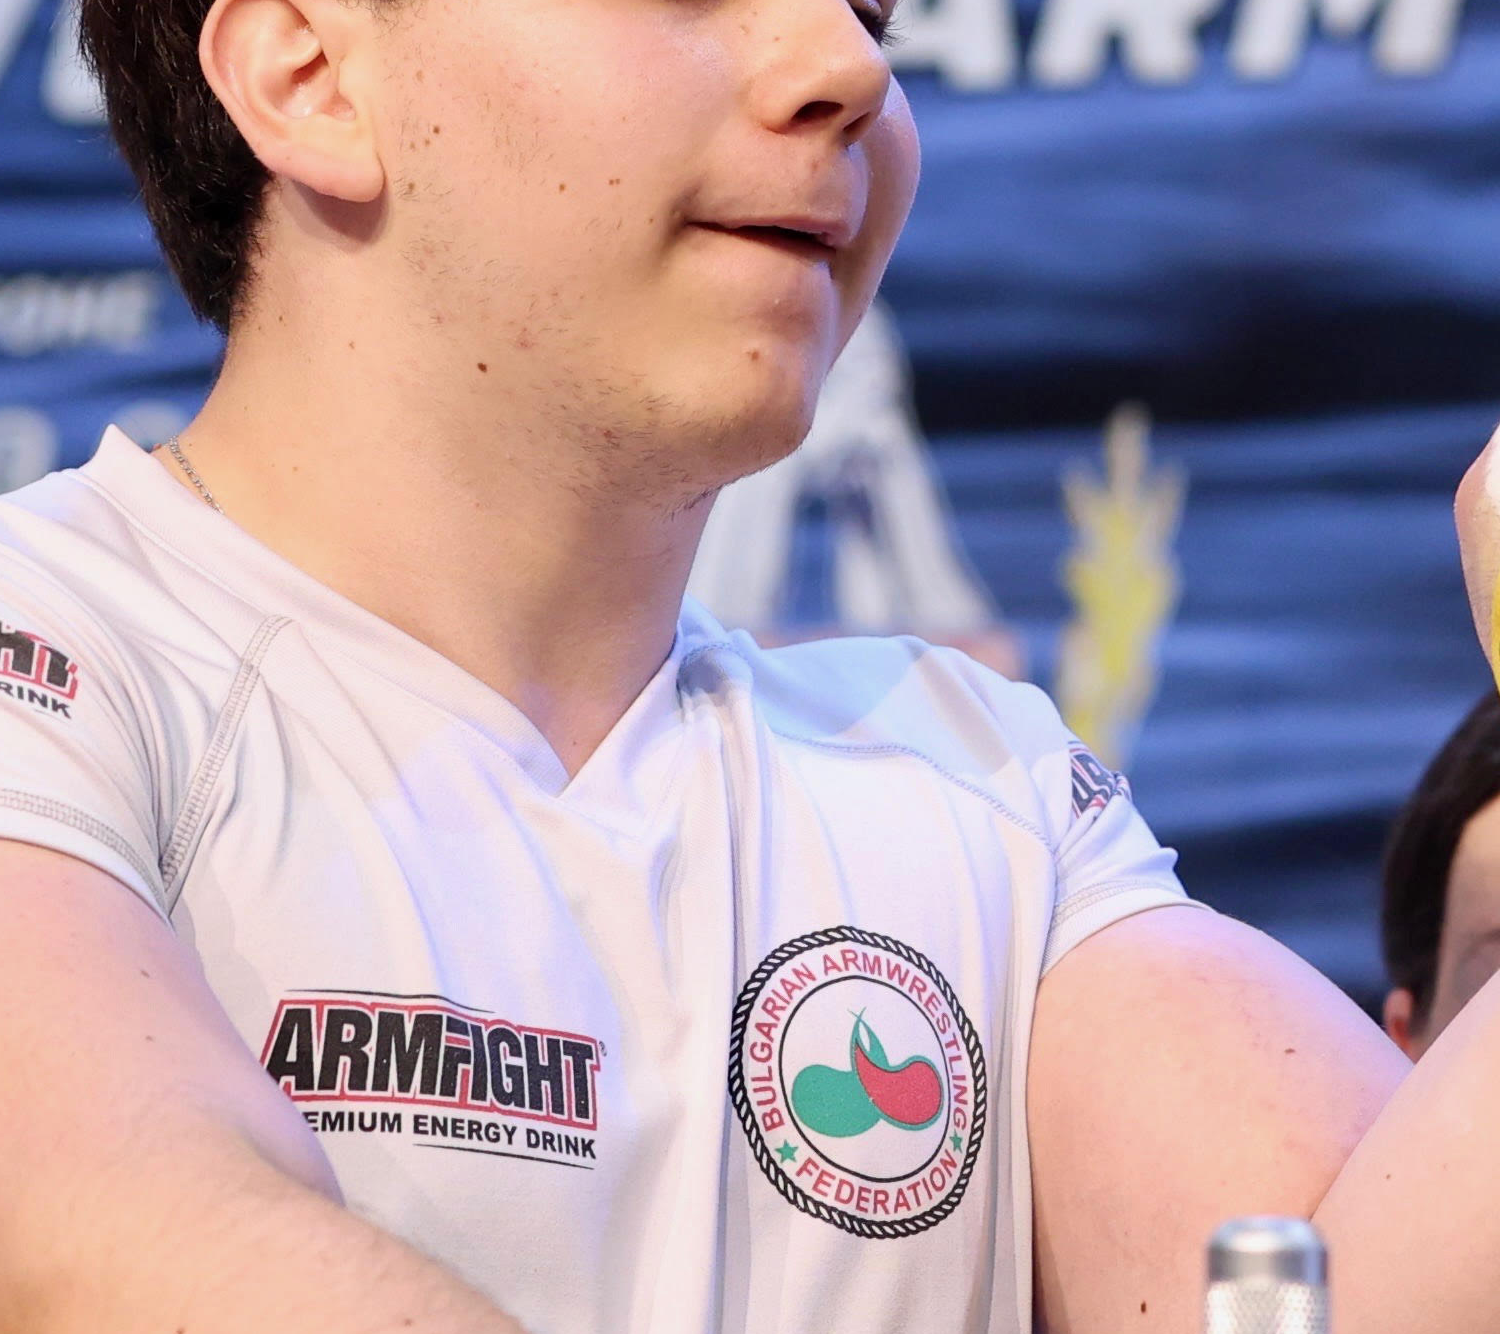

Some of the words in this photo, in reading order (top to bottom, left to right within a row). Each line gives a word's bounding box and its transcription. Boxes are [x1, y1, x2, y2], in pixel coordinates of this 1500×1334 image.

[262, 1004, 598, 1123] ARMFIGHT
[749, 963, 817, 1133] BULGARIAN
[821, 948, 969, 1132] ARMWRESTLING
[303, 1111, 402, 1134] EMIUM
[412, 1114, 518, 1146] ENERGY
[525, 1127, 598, 1160] DRINK
[795, 1148, 958, 1215] FEDERATION
